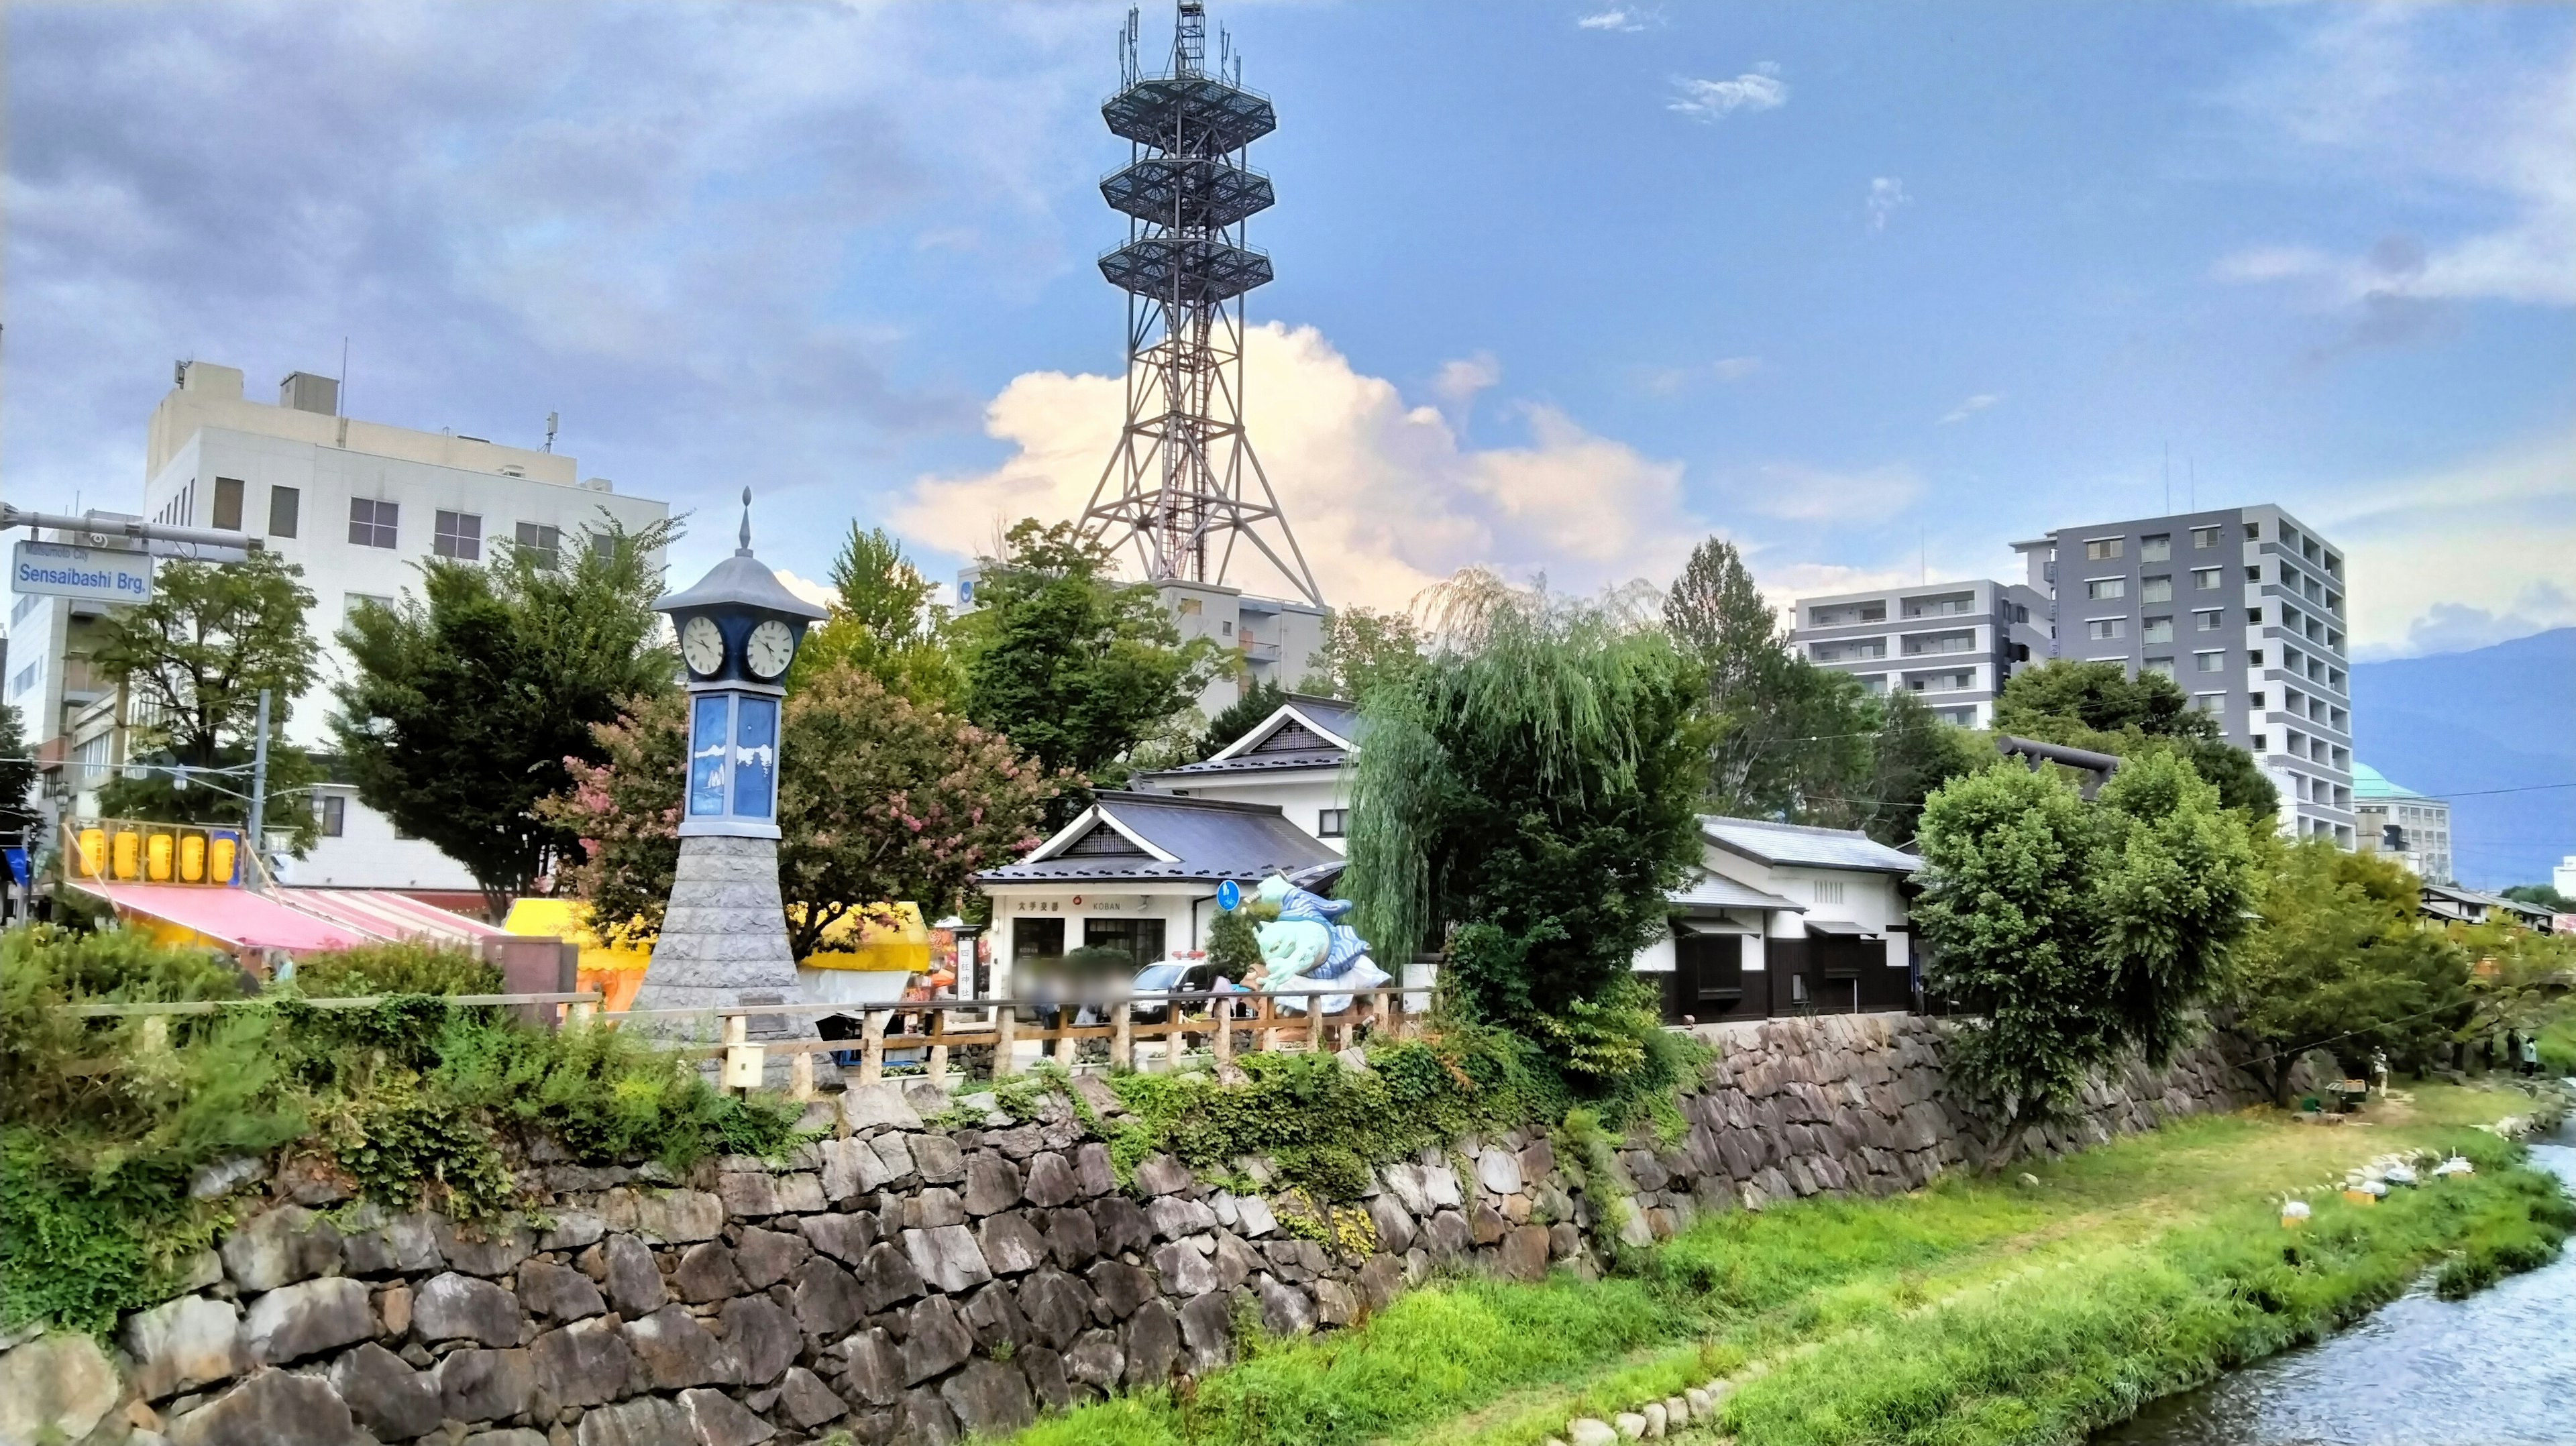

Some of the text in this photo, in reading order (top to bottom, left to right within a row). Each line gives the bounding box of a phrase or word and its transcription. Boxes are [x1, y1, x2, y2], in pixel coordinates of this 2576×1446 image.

[25, 543, 90, 562] Matsumoto City
[19, 563, 146, 594] Sensaibashi Brg.
[1093, 903, 1120, 911] KOBAN
